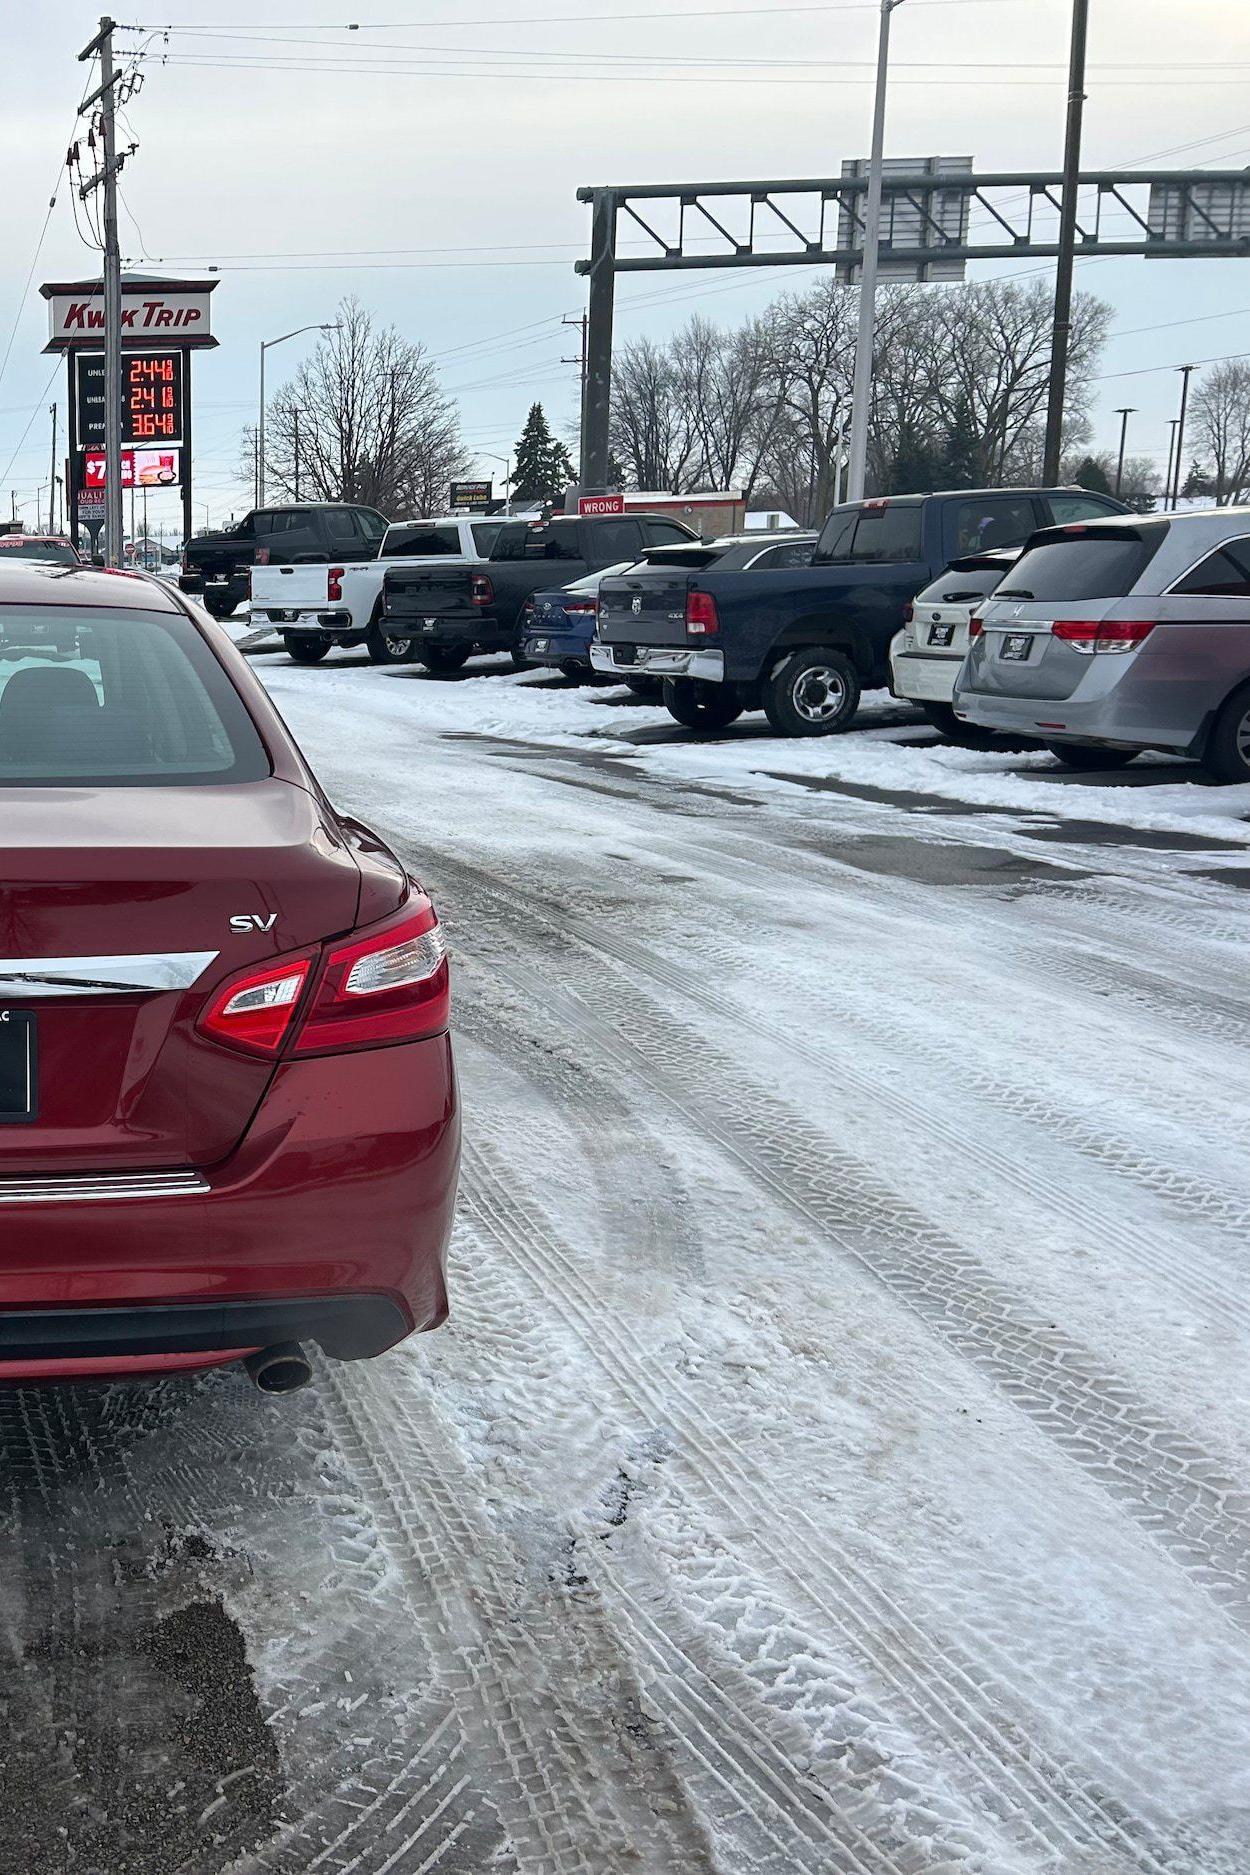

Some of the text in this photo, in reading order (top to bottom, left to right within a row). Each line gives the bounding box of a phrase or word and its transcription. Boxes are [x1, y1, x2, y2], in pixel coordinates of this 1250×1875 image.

[142, 302, 202, 327] TRIP
[583, 501, 619, 513] WRONG
[229, 913, 278, 933] SV
